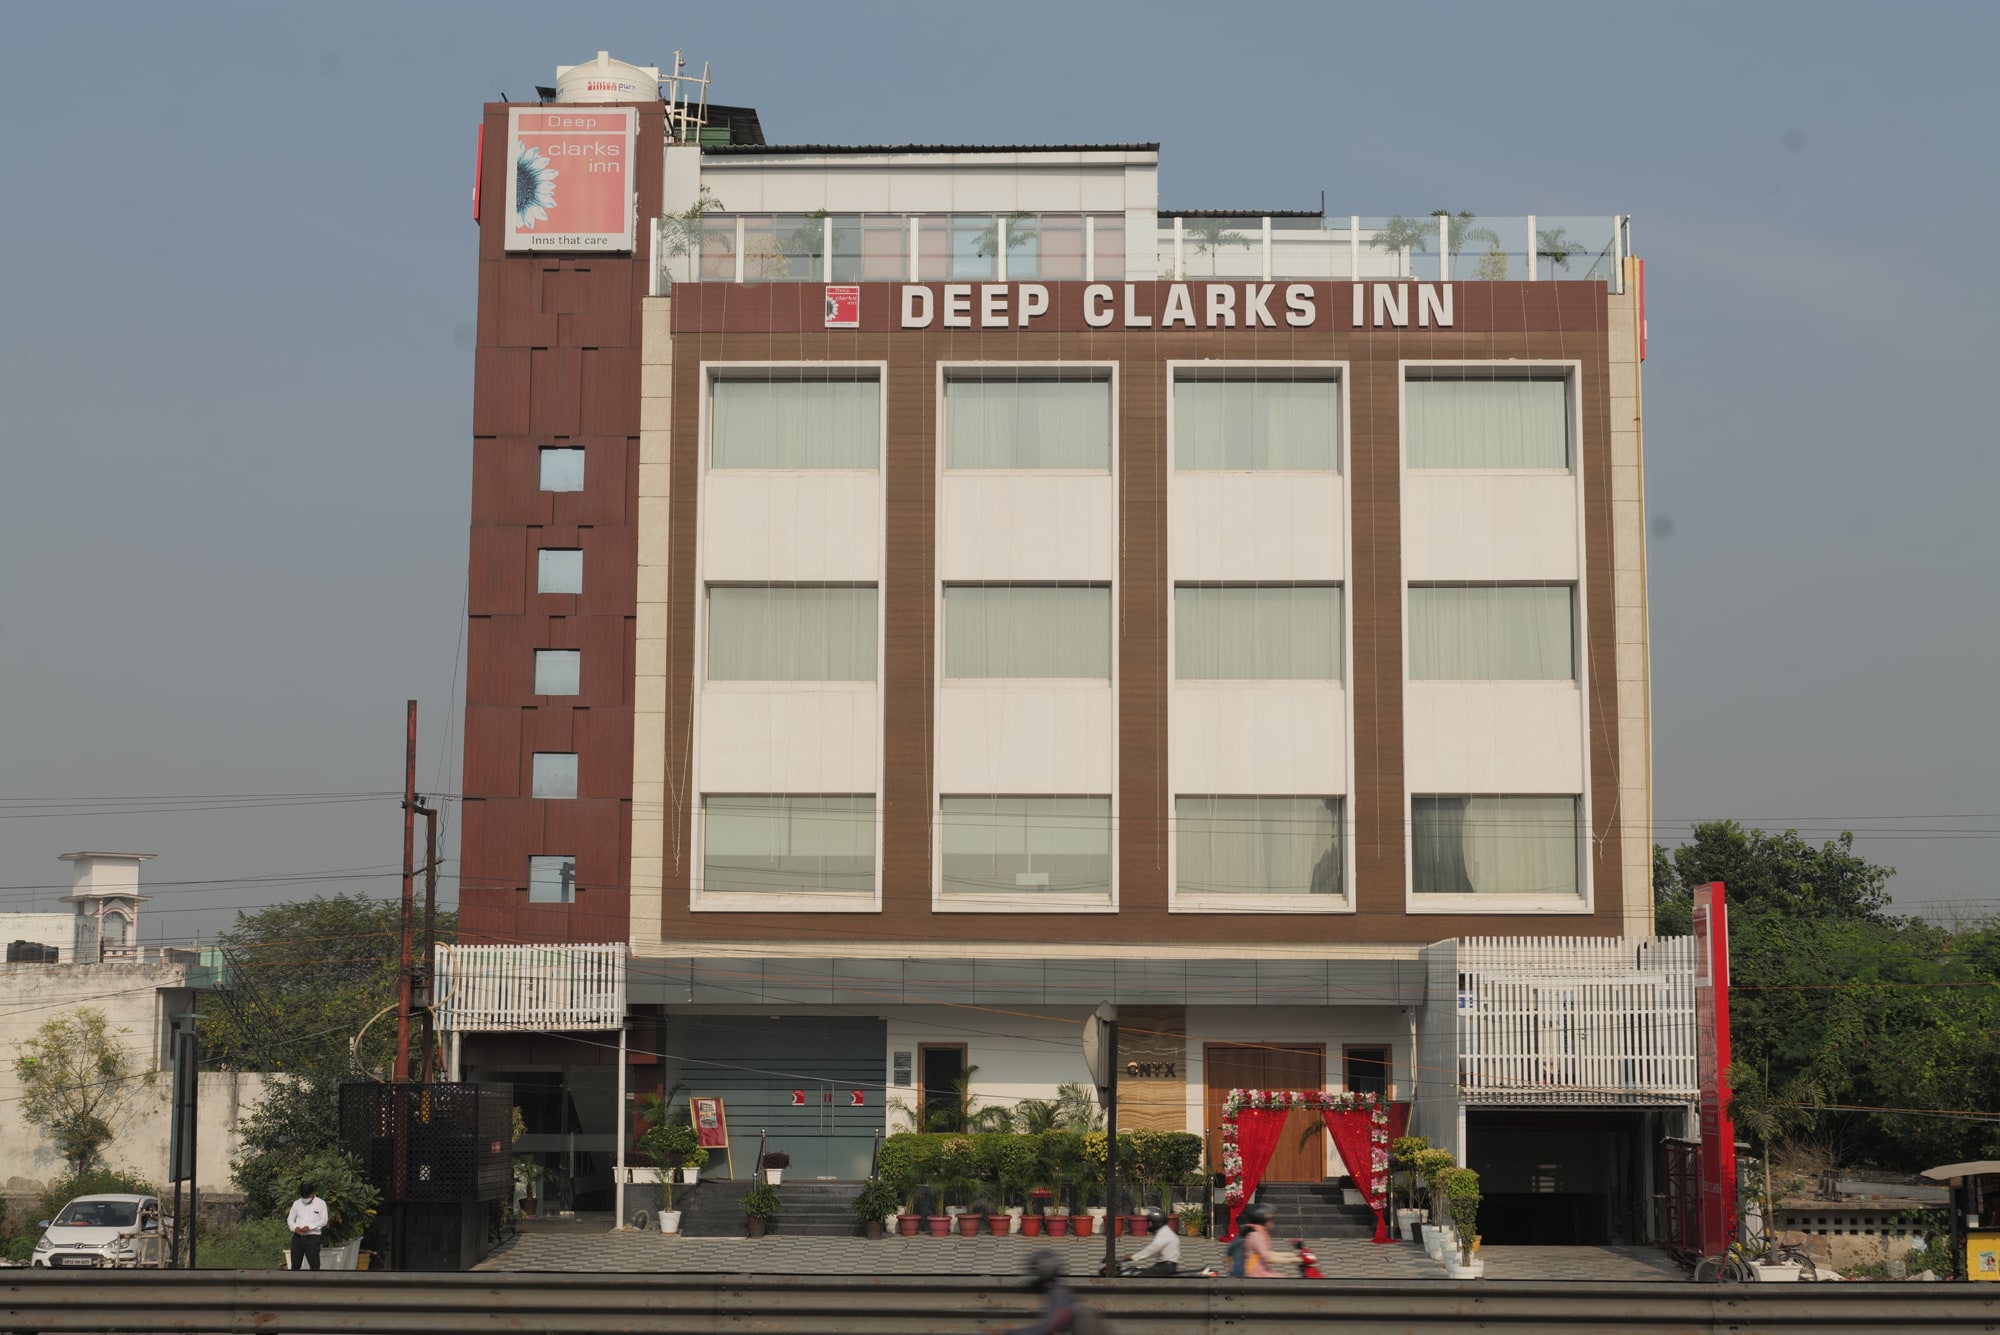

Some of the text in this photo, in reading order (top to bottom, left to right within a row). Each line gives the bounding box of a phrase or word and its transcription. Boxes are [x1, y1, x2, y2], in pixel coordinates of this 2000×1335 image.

[548, 115, 597, 129] Deep
[548, 141, 620, 156] clarks
[589, 159, 620, 173] inn
[532, 235, 608, 245] Inns that care
[901, 283, 1454, 328] DEEP CLARKS INN
[1127, 1060, 1177, 1078] ONYX
